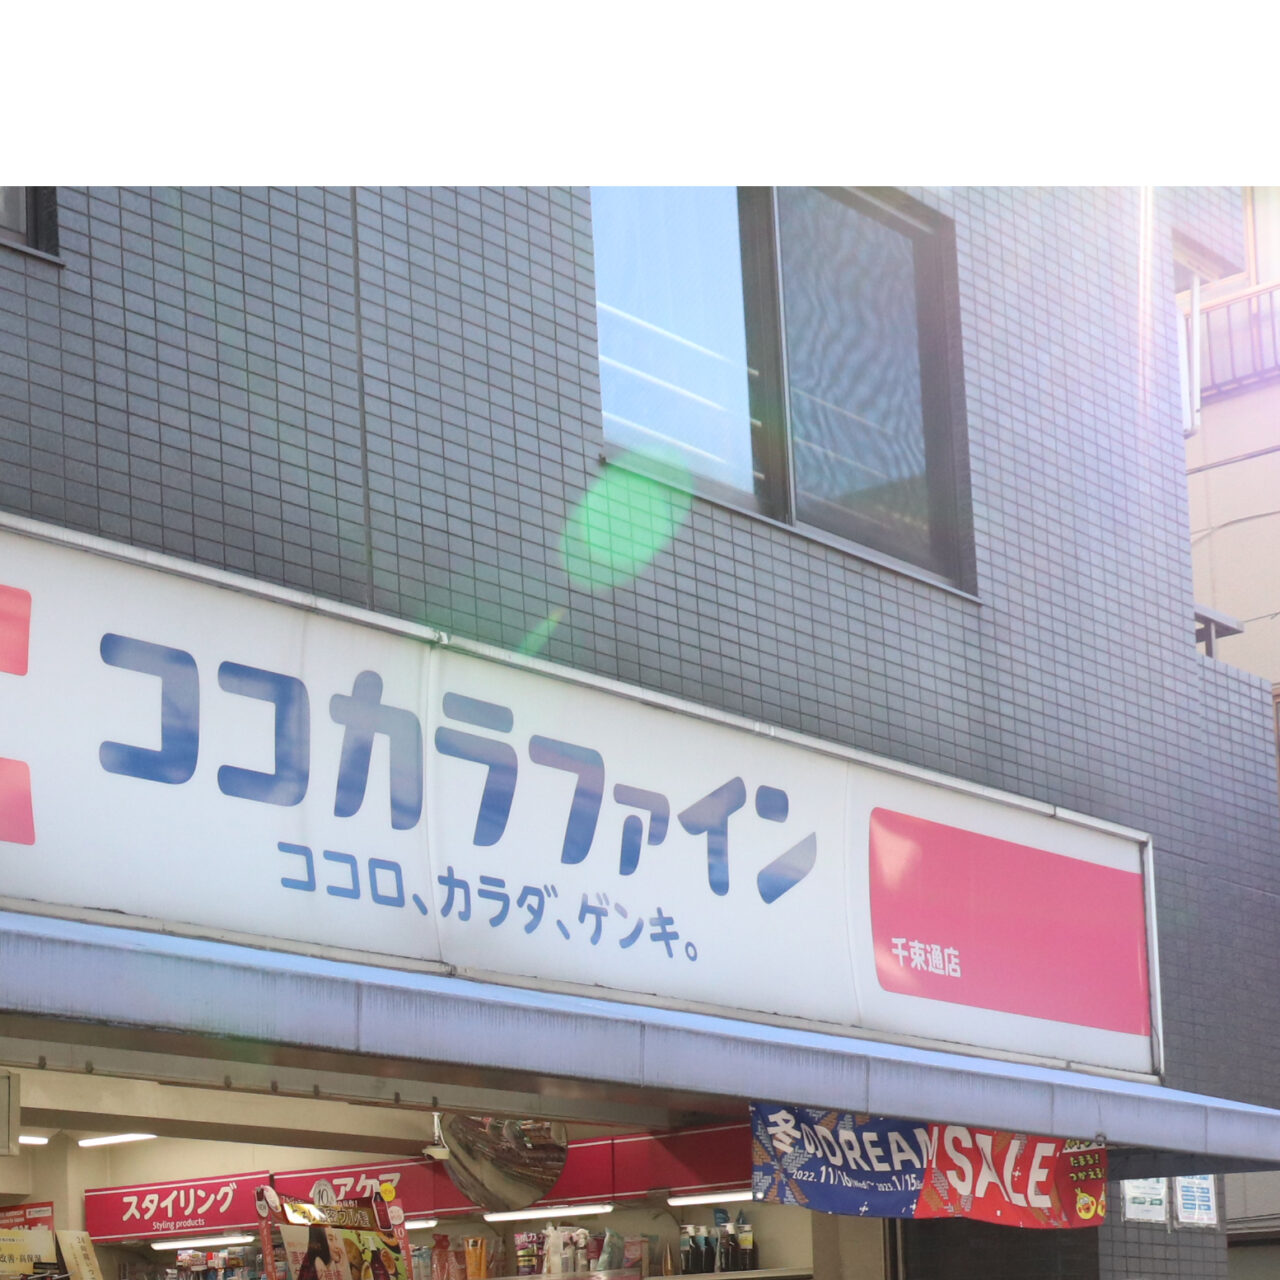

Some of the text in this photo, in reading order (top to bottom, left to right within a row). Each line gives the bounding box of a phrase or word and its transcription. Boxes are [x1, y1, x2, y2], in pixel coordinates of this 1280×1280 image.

[99, 632, 818, 905] ココカラファイン
[277, 840, 700, 964] ココロ、カラダ、ゲンキ。
[891, 937, 962, 978] 千束通店
[121, 1182, 238, 1223] スタイリング
[152, 1217, 205, 1230] Styling products
